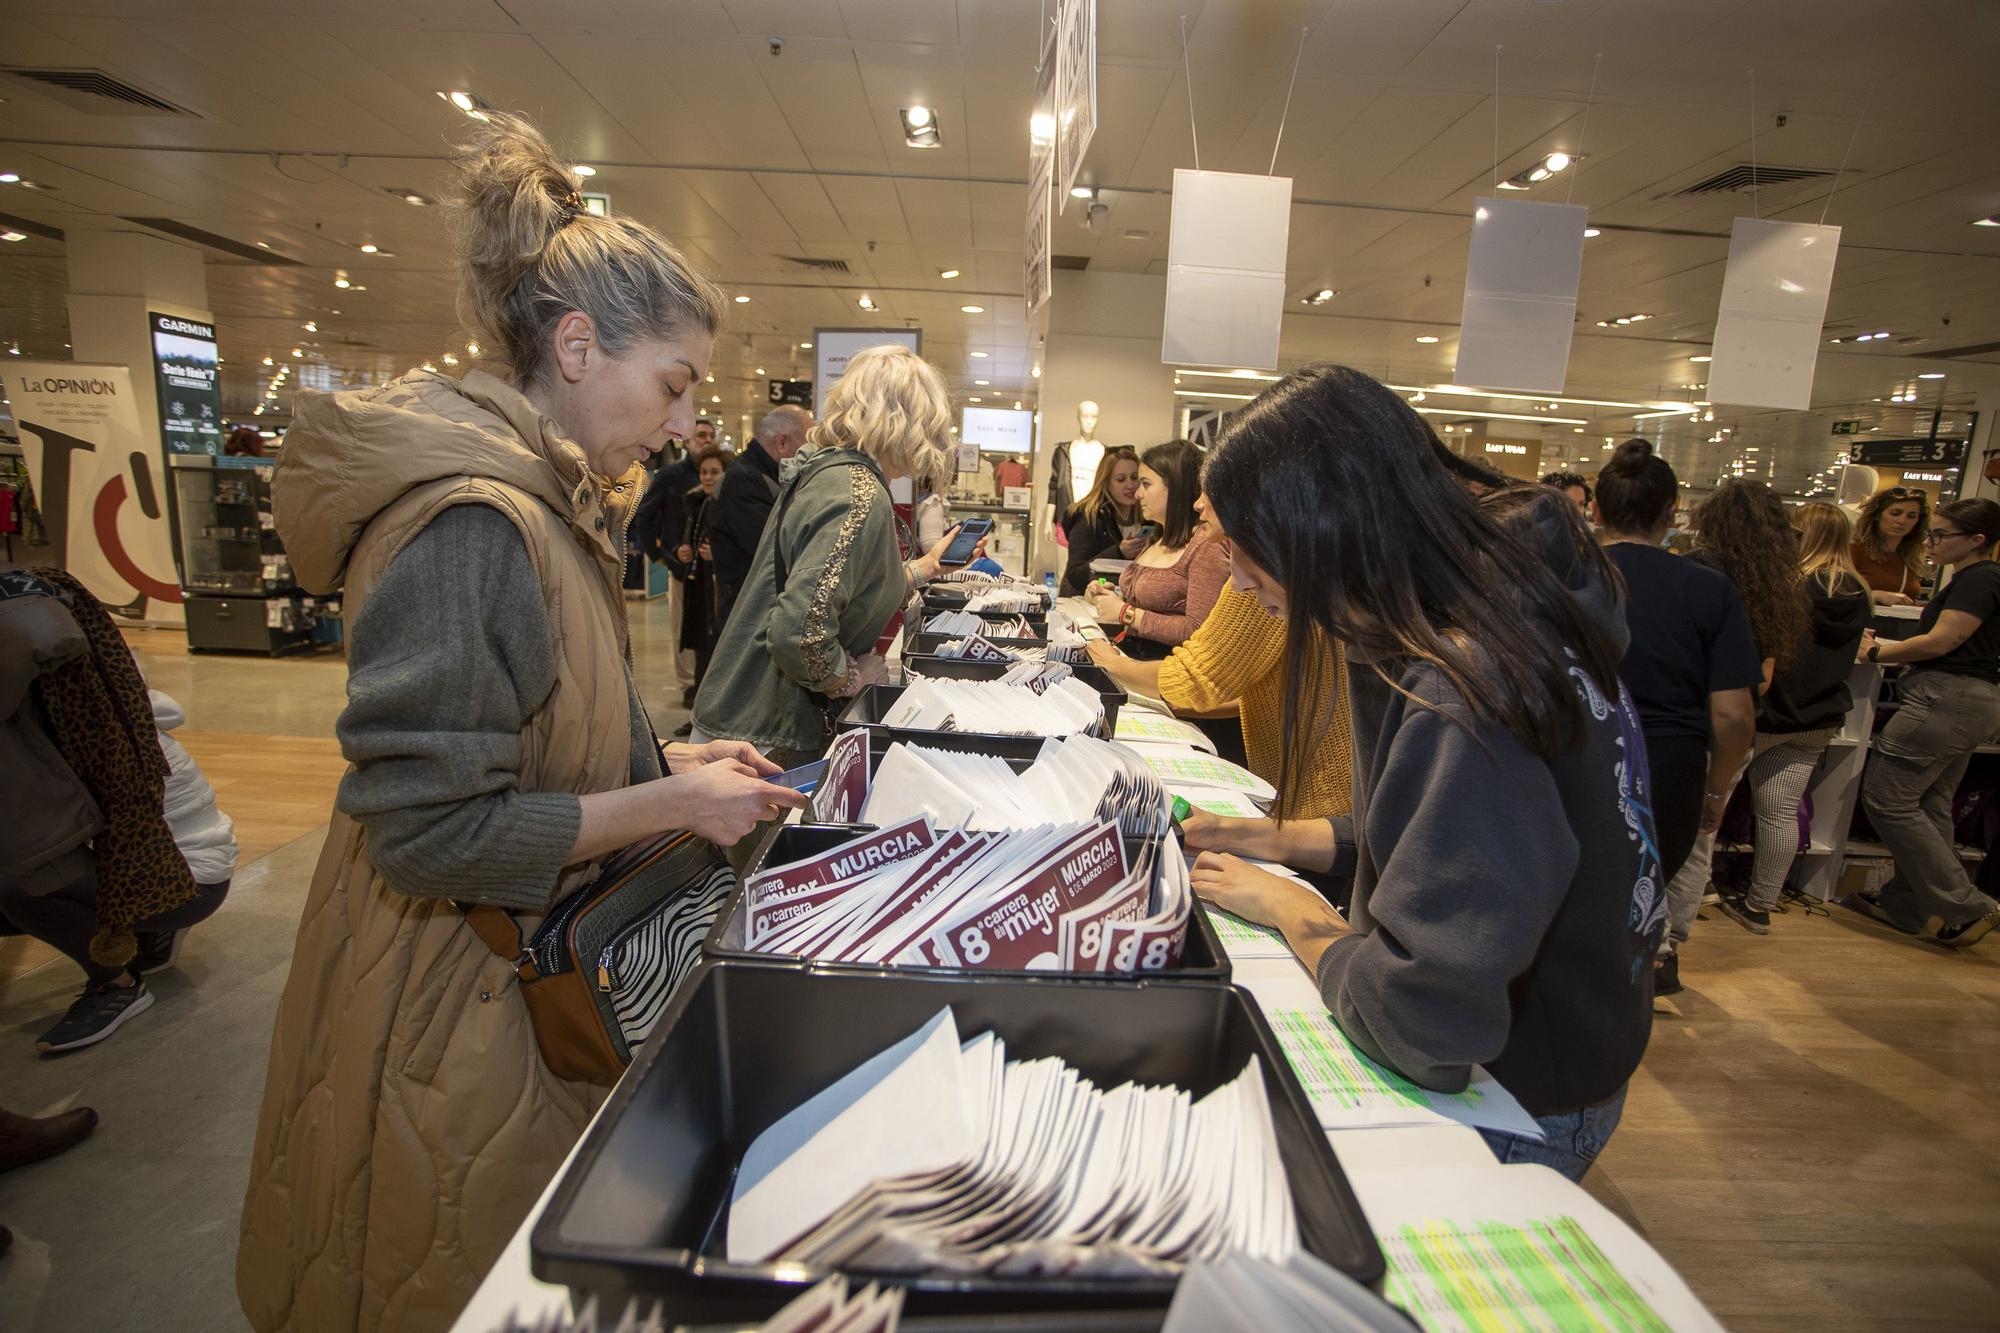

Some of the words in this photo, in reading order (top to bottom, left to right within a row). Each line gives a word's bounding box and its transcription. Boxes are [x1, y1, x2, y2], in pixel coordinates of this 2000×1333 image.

[159, 317, 214, 337] GARMIN
[770, 382, 784, 400] 3
[1851, 444, 1864, 462] 3
[1931, 442, 1946, 460] 3
[1903, 471, 1922, 480] EASY
[830, 831, 923, 881] MURCIA
[1060, 837, 1115, 886] MURCIA
[1068, 886, 1076, 897] 5
[1073, 880, 1083, 894] DE
[1081, 865, 1103, 888] MARZO
[1101, 854, 1118, 872] 2023
[772, 902, 812, 923] carrera
[983, 893, 1029, 929] carrera
[1002, 886, 1060, 941] mujer
